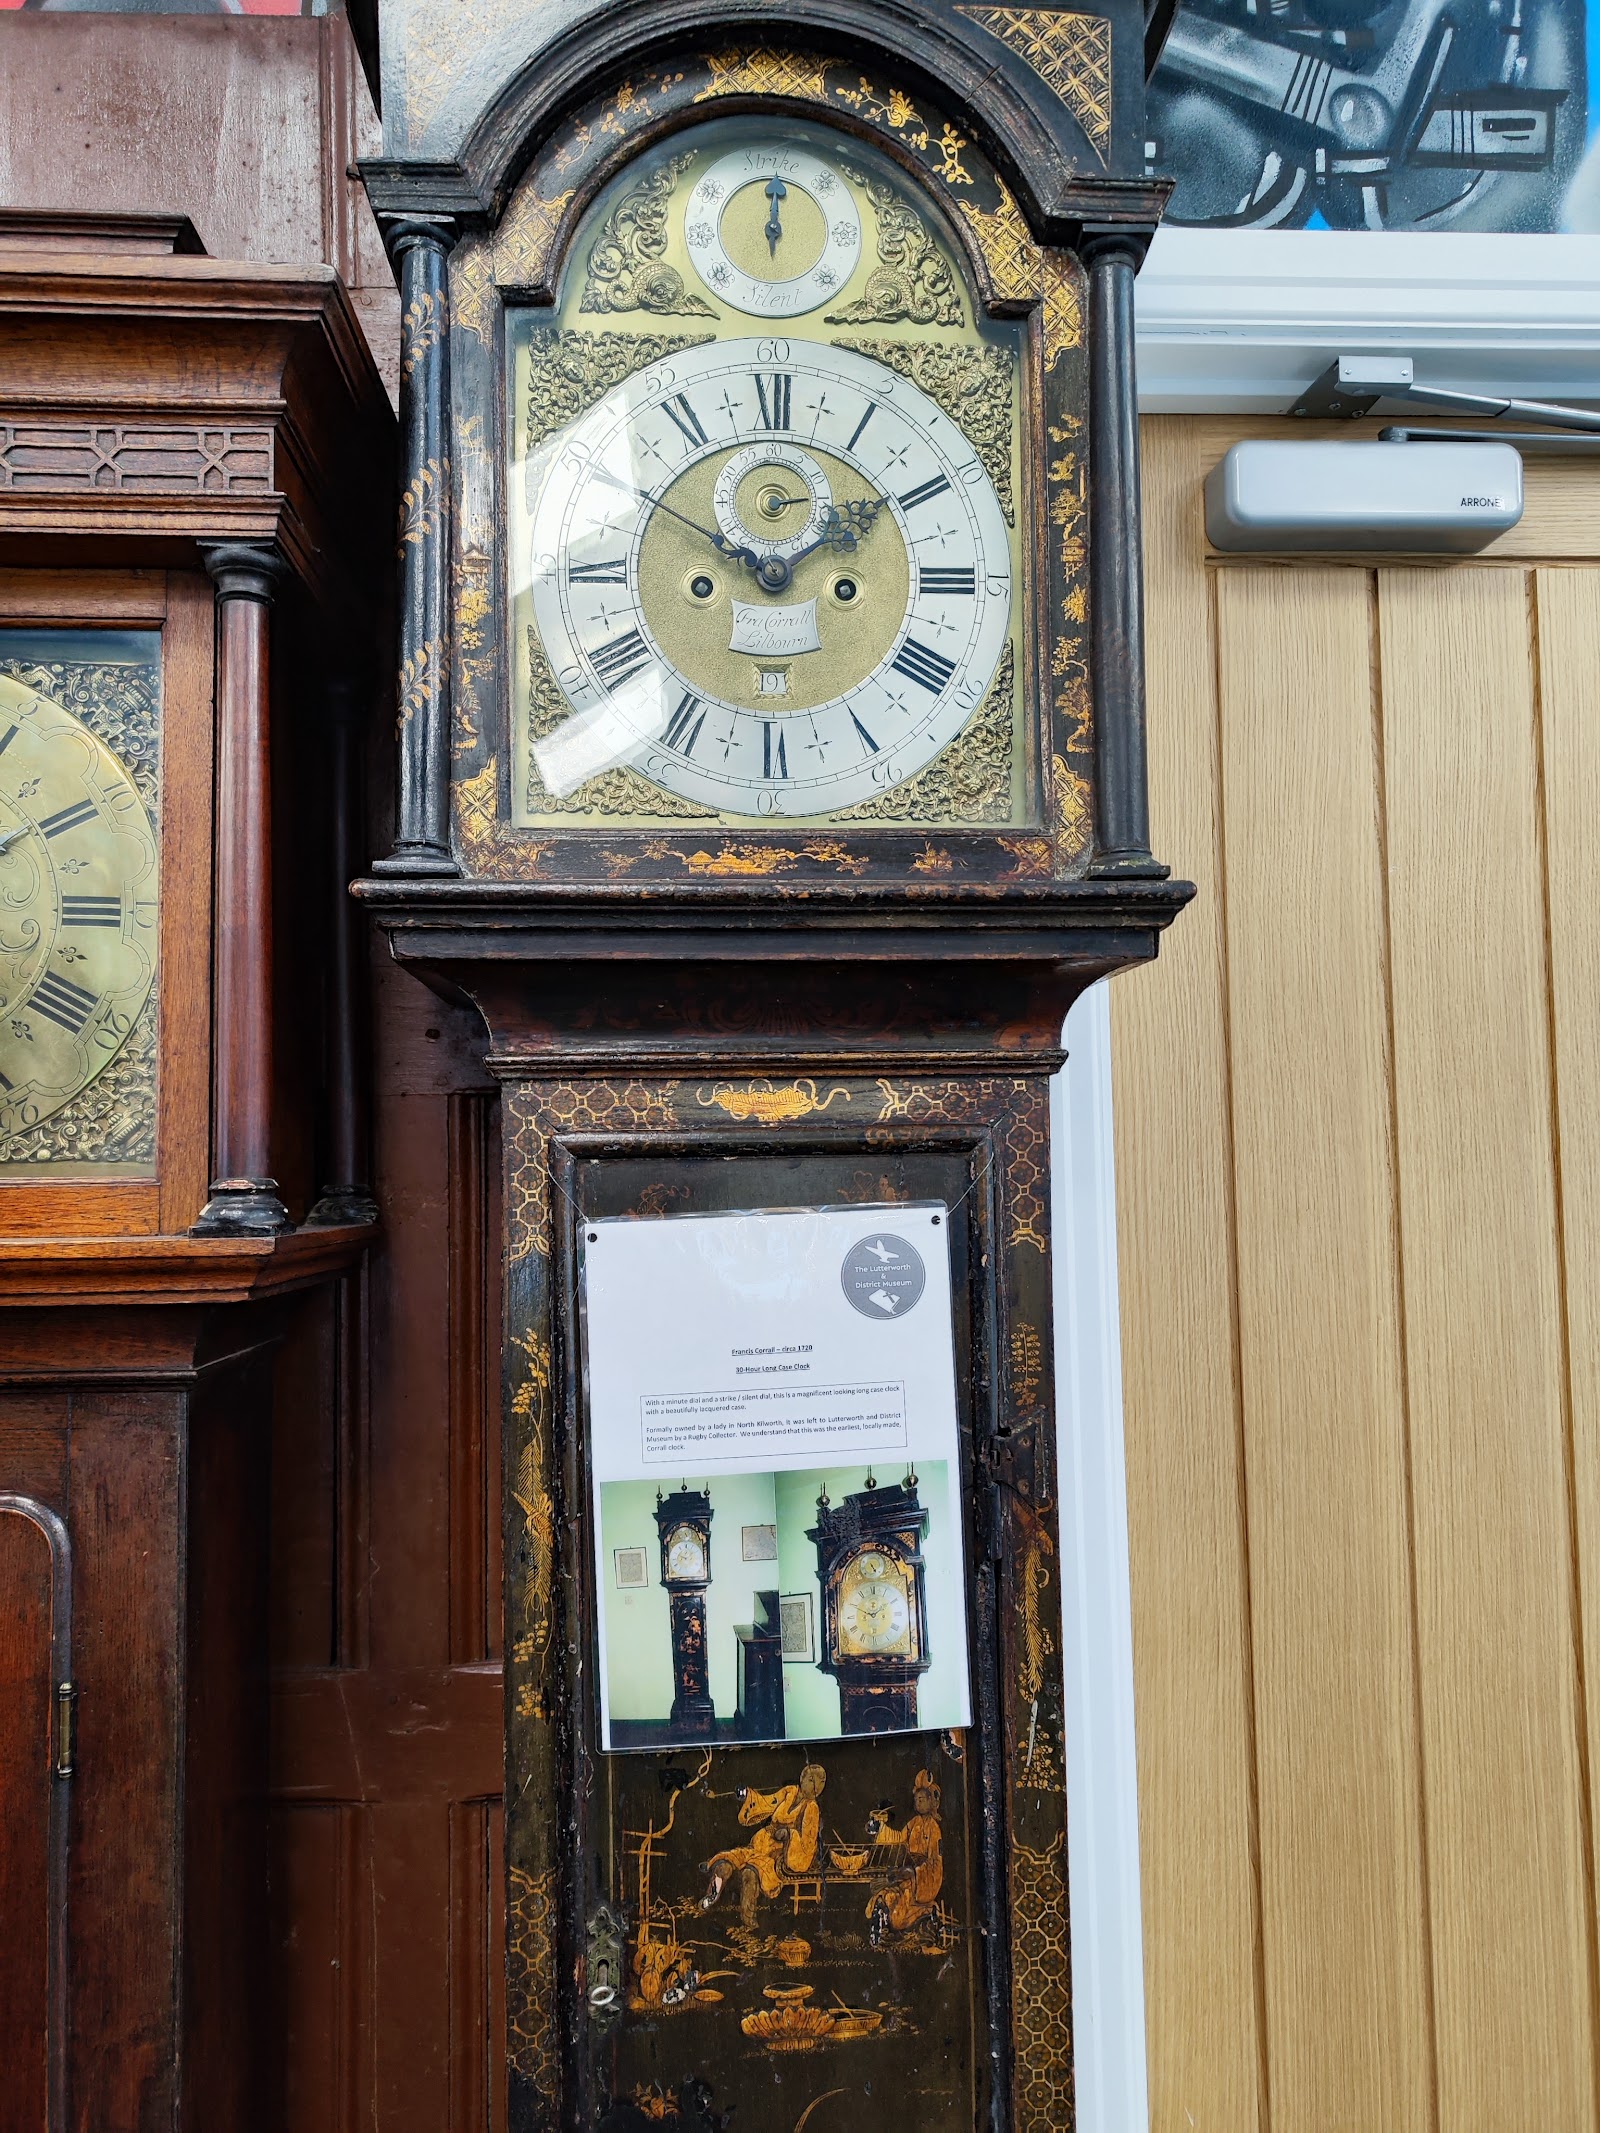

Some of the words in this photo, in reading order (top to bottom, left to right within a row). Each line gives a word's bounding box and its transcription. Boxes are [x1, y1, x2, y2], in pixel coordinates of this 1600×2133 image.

[743, 149, 800, 174] Strike
[742, 283, 804, 308] Silent
[757, 338, 790, 363] 60
[645, 360, 676, 392] 55
[876, 375, 905, 394] 5
[746, 373, 798, 432] XII
[652, 389, 717, 459] XI
[840, 397, 883, 456] I
[561, 440, 591, 476] 50
[740, 447, 756, 465] 55
[765, 443, 782, 458] 60
[794, 455, 810, 464] 5
[720, 465, 736, 483] 50
[809, 471, 825, 484] 10
[955, 457, 984, 485] 10
[715, 487, 729, 508] 45
[892, 465, 954, 520] II
[1460, 497, 1501, 508] ARRONE
[720, 517, 738, 535] 40
[534, 553, 557, 586] 45
[569, 552, 628, 591] IX
[918, 557, 975, 601] III
[987, 571, 1010, 604] 15
[765, 610, 812, 633] Corrall
[737, 631, 808, 649] Lilbourn
[584, 622, 654, 700] VIII
[885, 629, 960, 704] IIII
[559, 665, 592, 700] 40
[760, 672, 778, 692] 19
[953, 674, 984, 710] 20
[17, 695, 47, 716] 5
[653, 687, 709, 761] VII
[845, 701, 887, 761] V
[754, 720, 795, 779] VI
[640, 755, 679, 786] 35
[872, 759, 903, 792] 25
[103, 779, 136, 812] 10
[757, 789, 791, 816] 30
[33, 792, 102, 845] II
[60, 890, 121, 932] III
[21, 966, 102, 1040] IIII
[94, 1007, 131, 1050] 20
[854, 1265, 868, 1273] The
[869, 1263, 911, 1272] Lutterworth
[855, 1281, 881, 1289] District
[882, 1280, 913, 1288] Museum
[731, 1347, 754, 1355] Francis
[735, 1366, 761, 1374] 30-Hour
[796, 1390, 833, 1399] magnificent
[833, 1388, 856, 1396] looking
[665, 1406, 698, 1414] beautifully
[699, 1405, 730, 1413] lacquered
[646, 1426, 673, 1434] Formally
[674, 1424, 696, 1432] owned
[828, 1414, 864, 1423] Lutterworth
[646, 1435, 674, 1443] Museum
[674, 1434, 683, 1442] by
[688, 1433, 708, 1441] Rugby
[751, 1428, 787, 1436] understand
